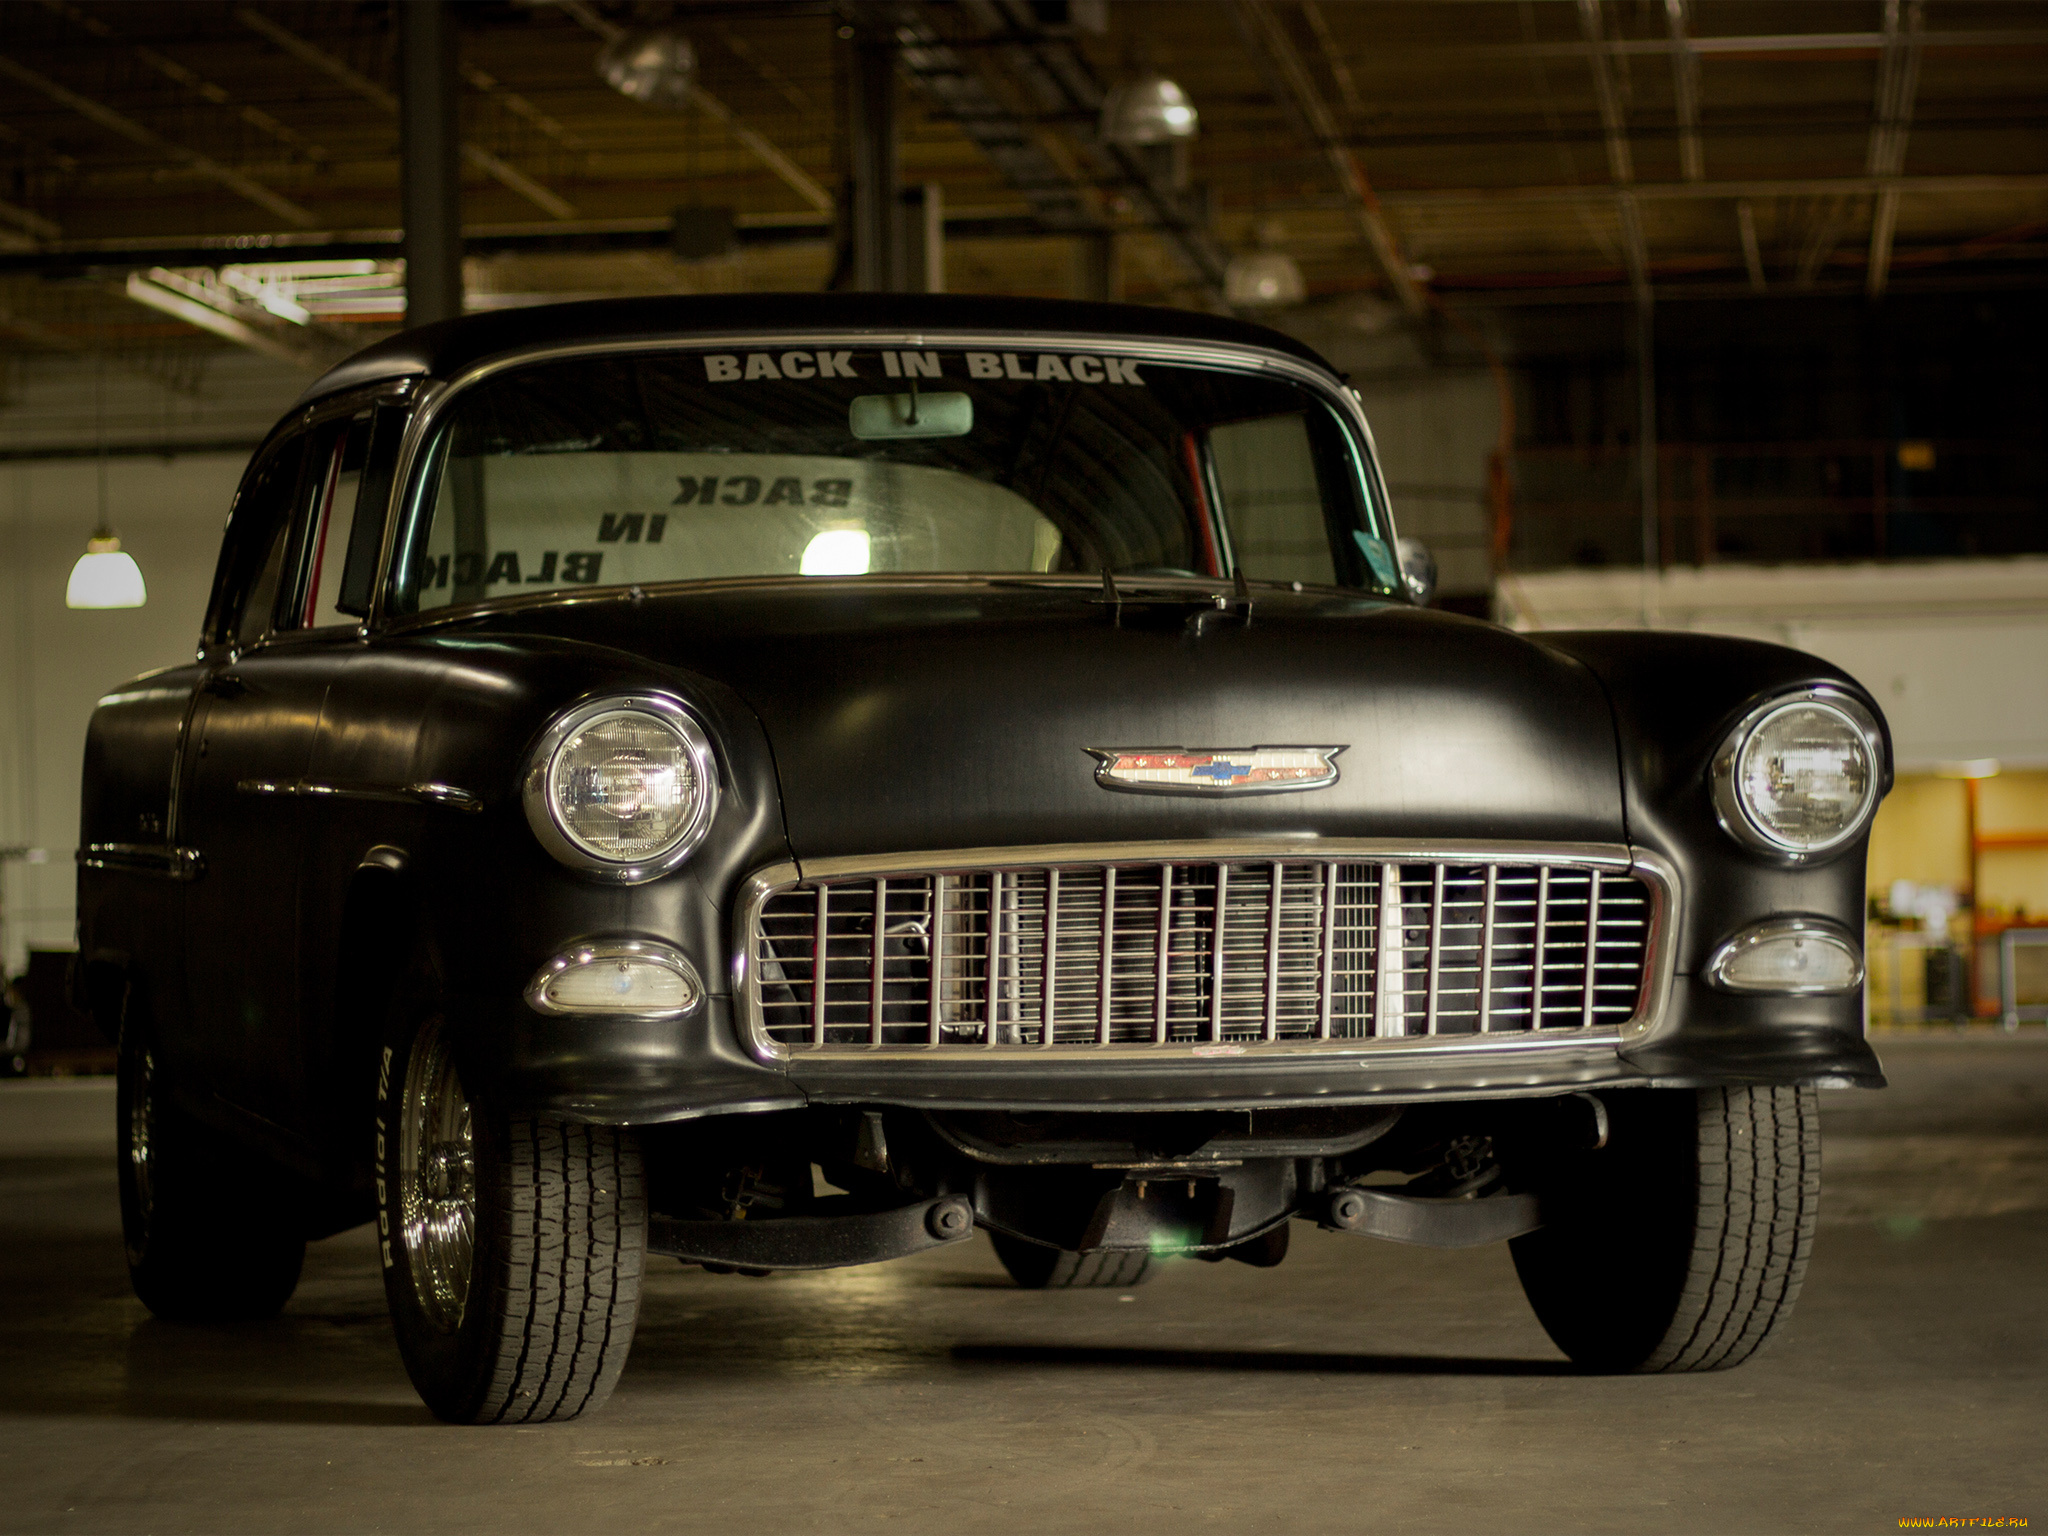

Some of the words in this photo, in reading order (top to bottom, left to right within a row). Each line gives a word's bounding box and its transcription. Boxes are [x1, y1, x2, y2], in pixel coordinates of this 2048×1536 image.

[704, 352, 857, 382] BACK
[882, 352, 942, 378] IN
[967, 352, 1145, 386] BLACK
[379, 1046, 392, 1101] T/A
[376, 1117, 393, 1268] Radial
